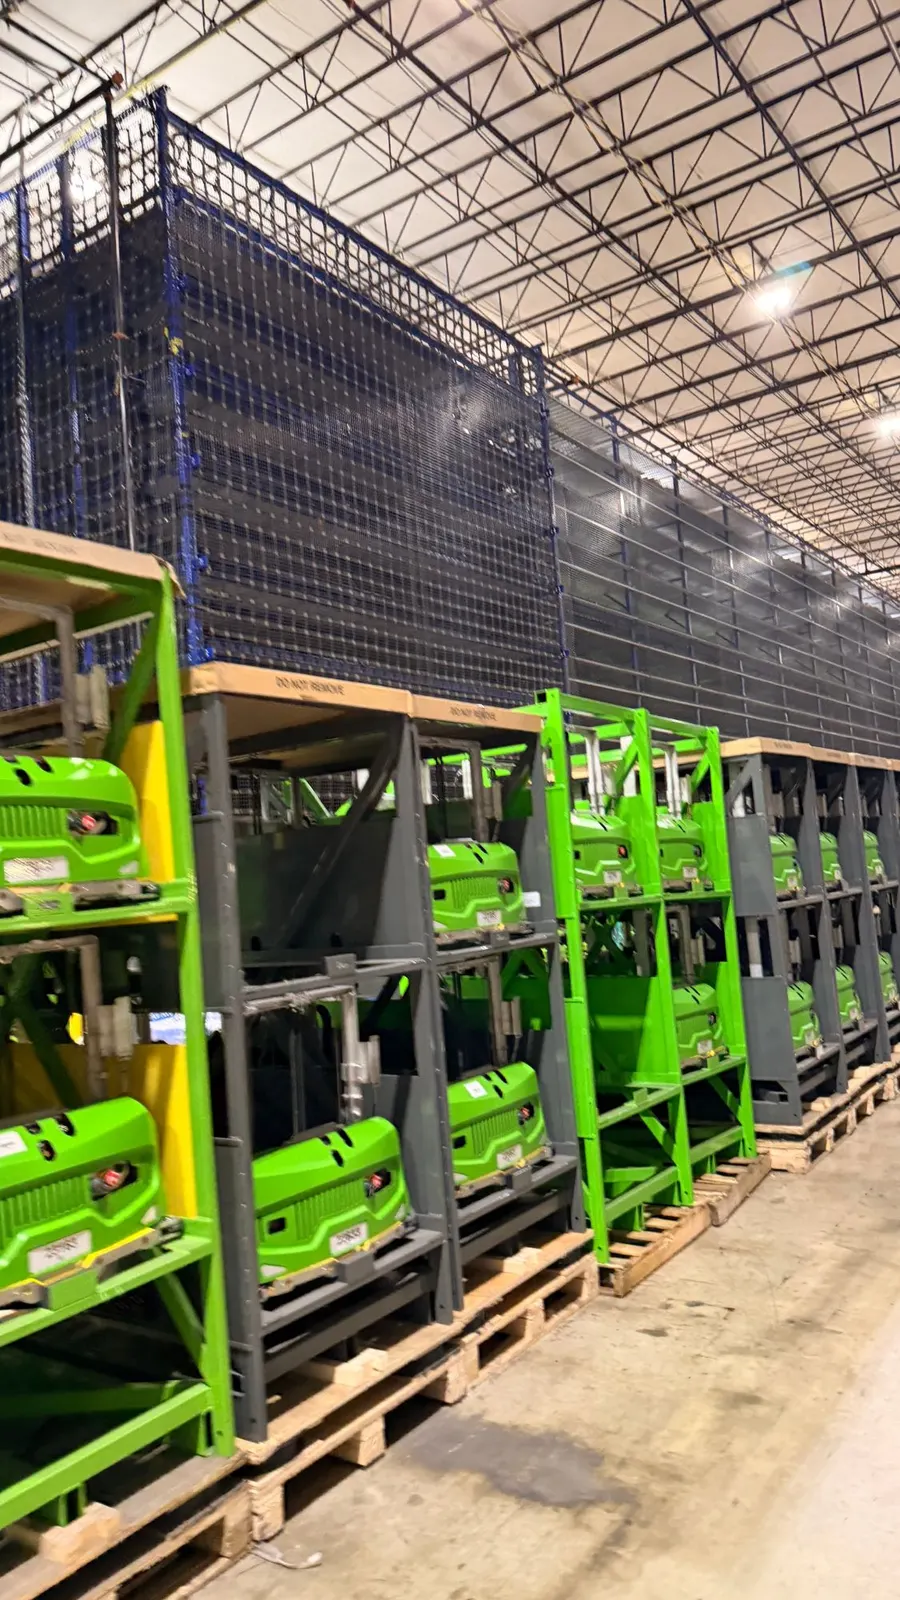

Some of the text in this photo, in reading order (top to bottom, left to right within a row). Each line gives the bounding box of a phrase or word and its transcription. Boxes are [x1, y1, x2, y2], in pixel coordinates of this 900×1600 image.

[276, 675, 345, 696] DO NOT REMOVE
